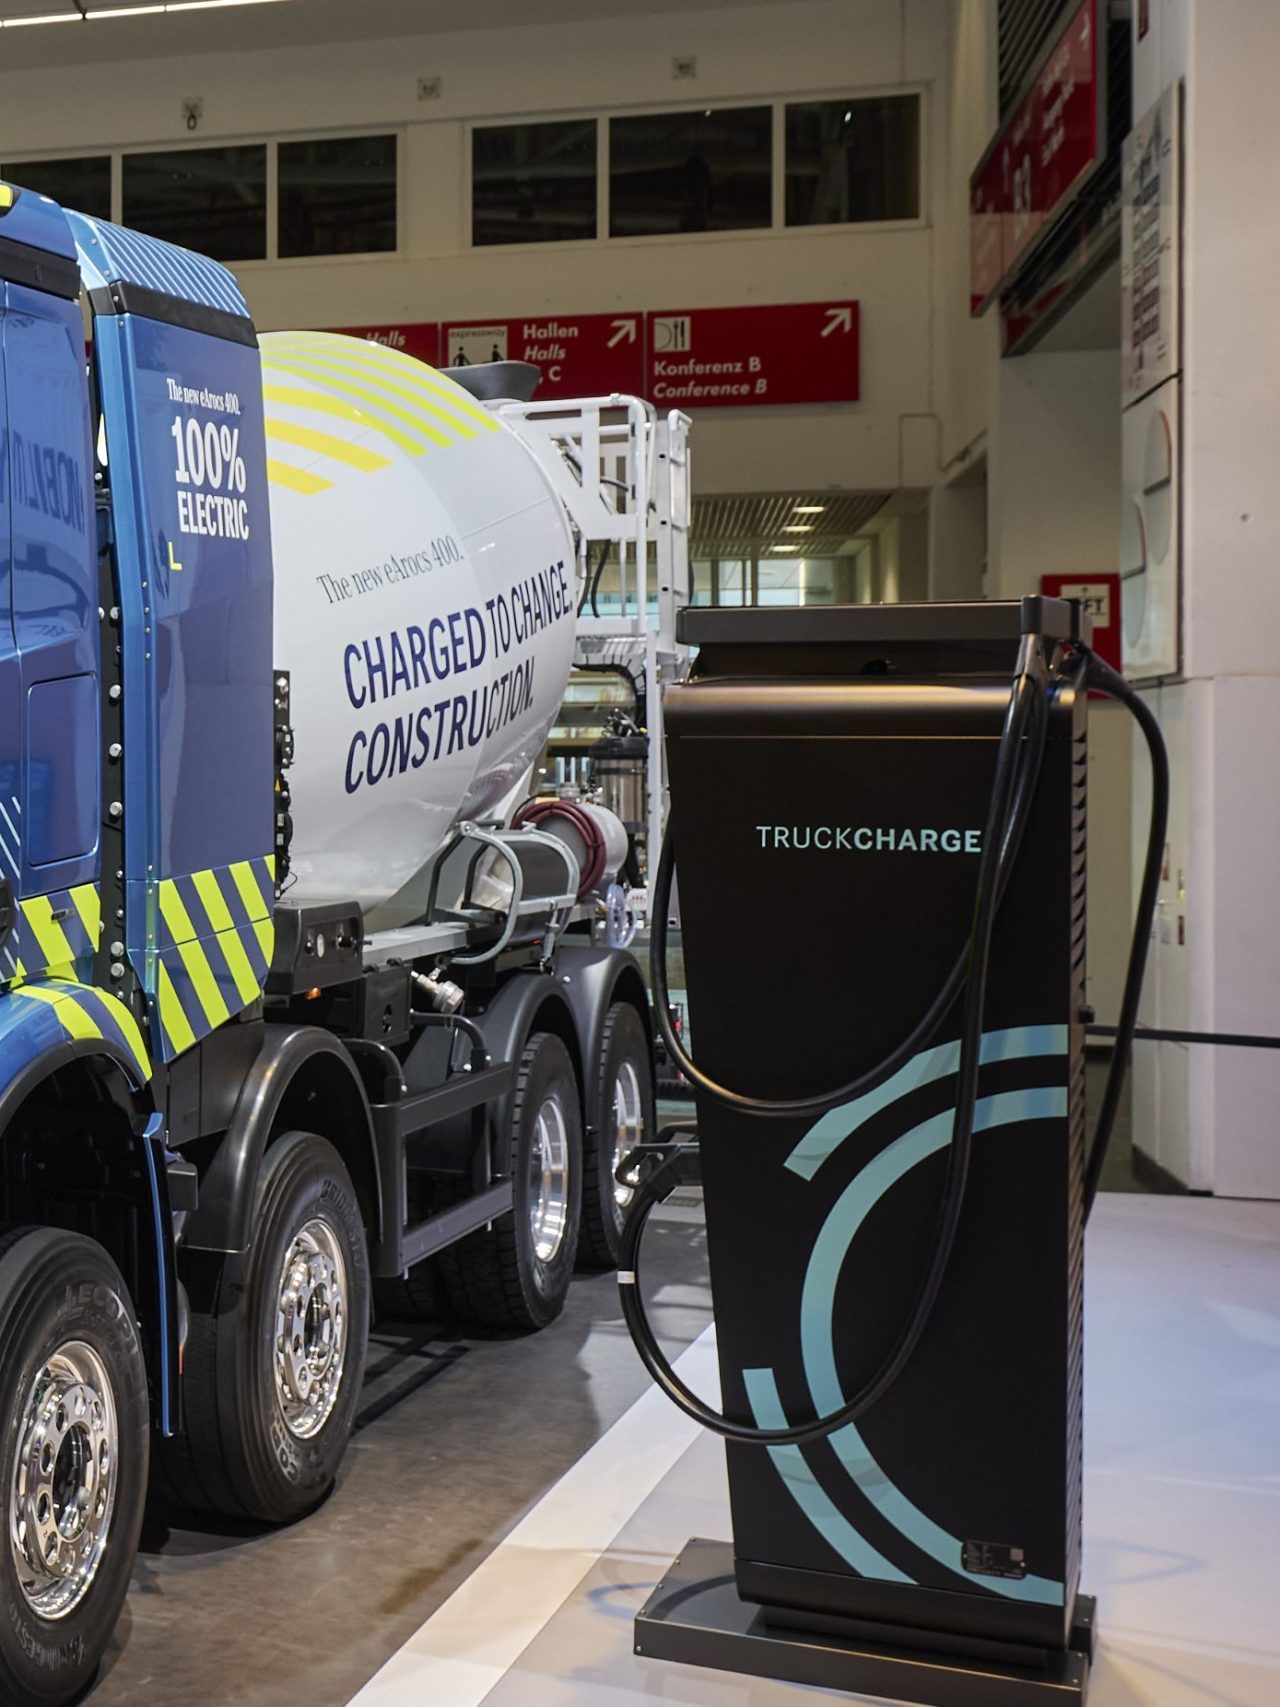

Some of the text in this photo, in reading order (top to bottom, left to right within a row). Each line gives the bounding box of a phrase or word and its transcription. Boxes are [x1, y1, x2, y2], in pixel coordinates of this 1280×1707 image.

[523, 324, 578, 340] Hallen
[523, 344, 566, 361] Halls
[654, 356, 761, 377] Konferenz B
[166, 378, 241, 416] The new eArocs 400.
[653, 378, 767, 399] Conference B
[171, 415, 247, 494] 100%
[177, 489, 250, 541] ELECTRIC
[317, 534, 464, 604] The new eArocs 400.
[344, 560, 573, 709] CHARGED TO CHANGE.
[345, 656, 535, 794] CONSTRUCTION.
[756, 826, 982, 853] TRUCKCHARGE
